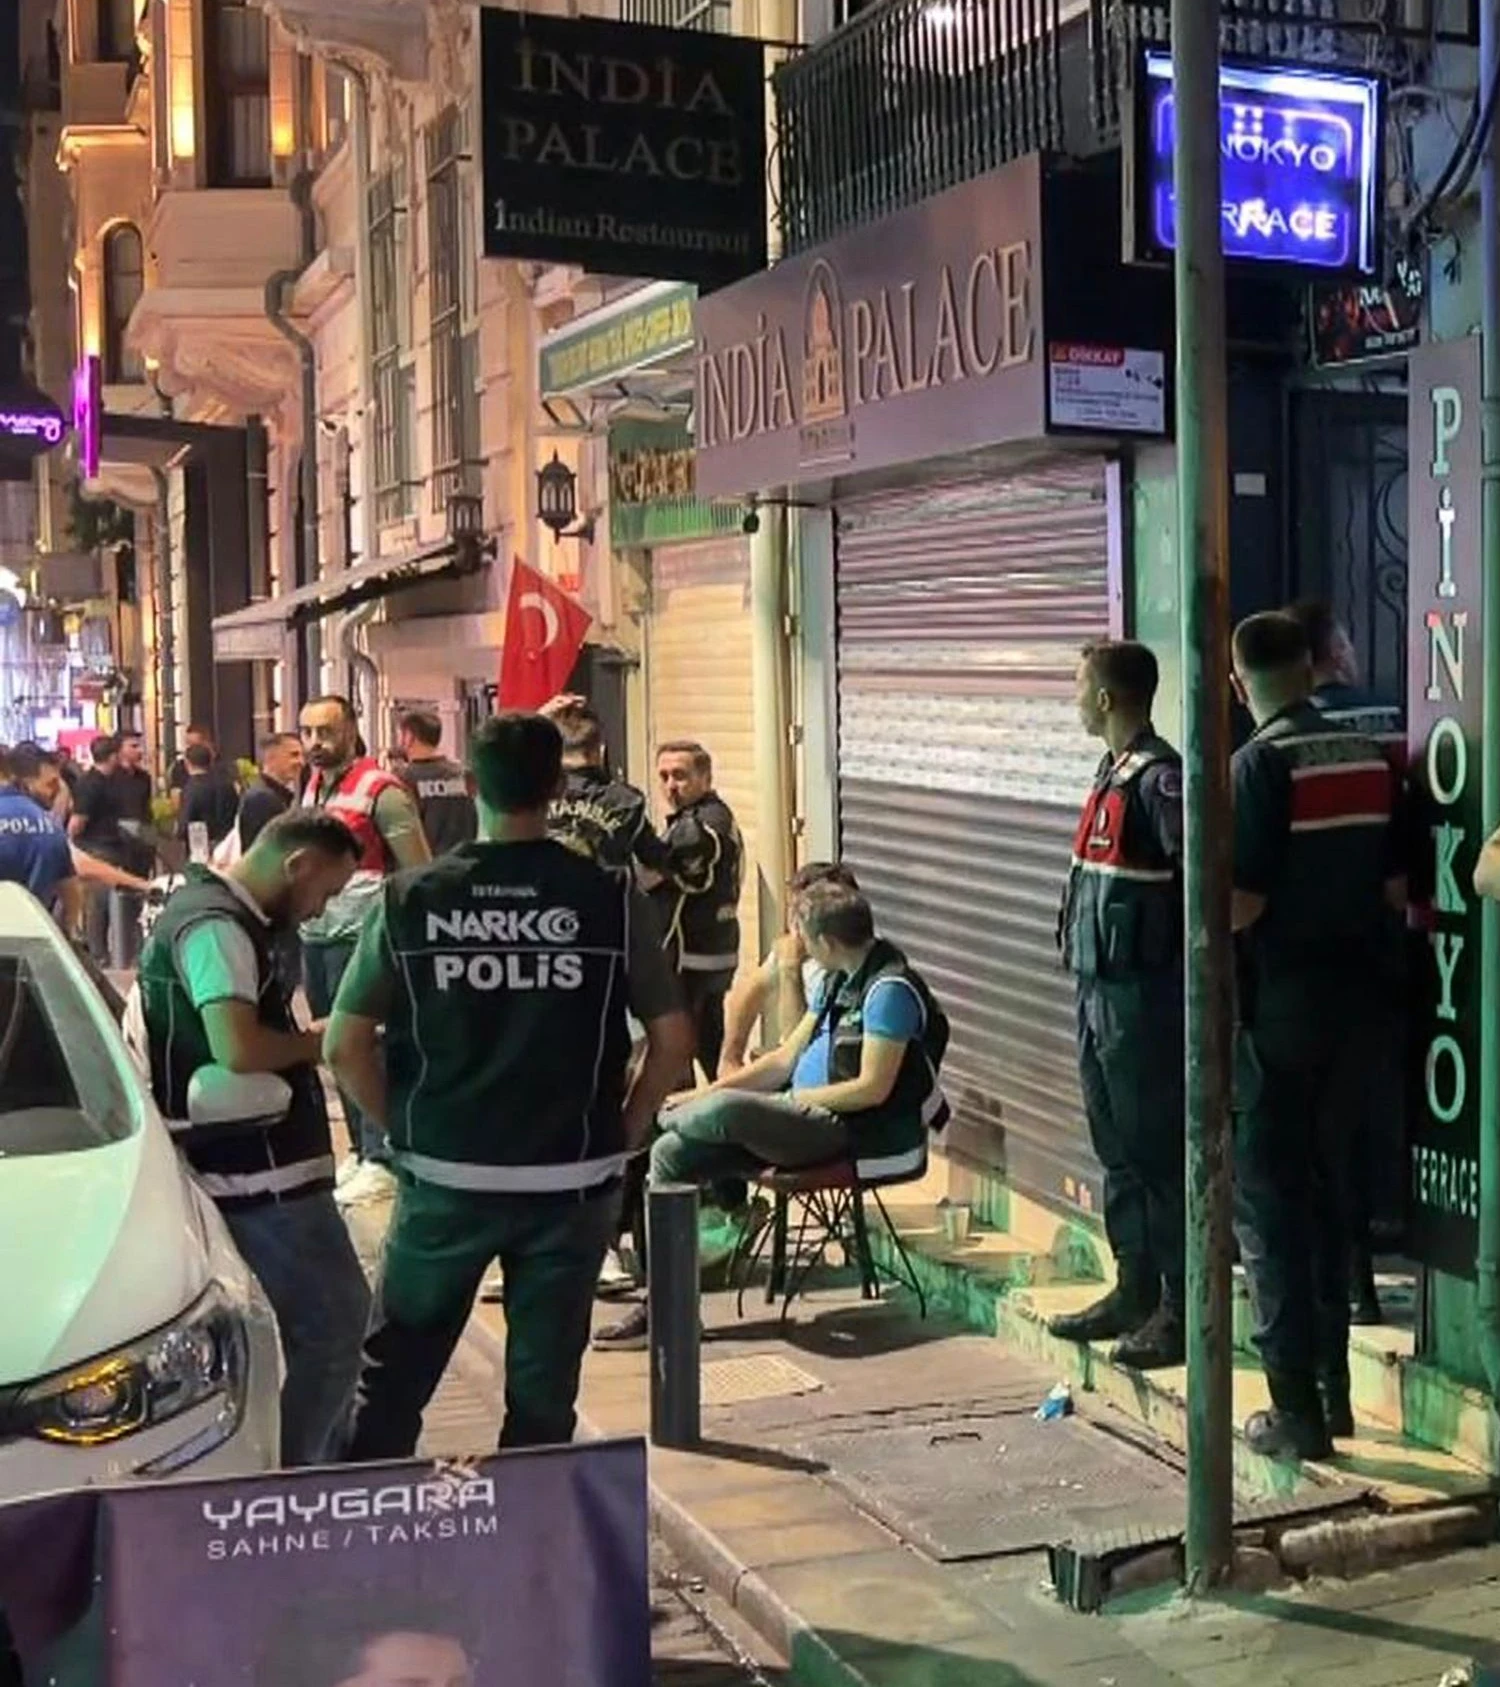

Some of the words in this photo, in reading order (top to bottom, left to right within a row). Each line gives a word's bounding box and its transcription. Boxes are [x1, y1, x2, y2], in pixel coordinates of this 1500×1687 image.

[851, 239, 1036, 405] PALACE
[434, 953, 584, 991] POLİS
[203, 1477, 496, 1531] YAYGARA
[206, 1529, 331, 1561] SAHNE
